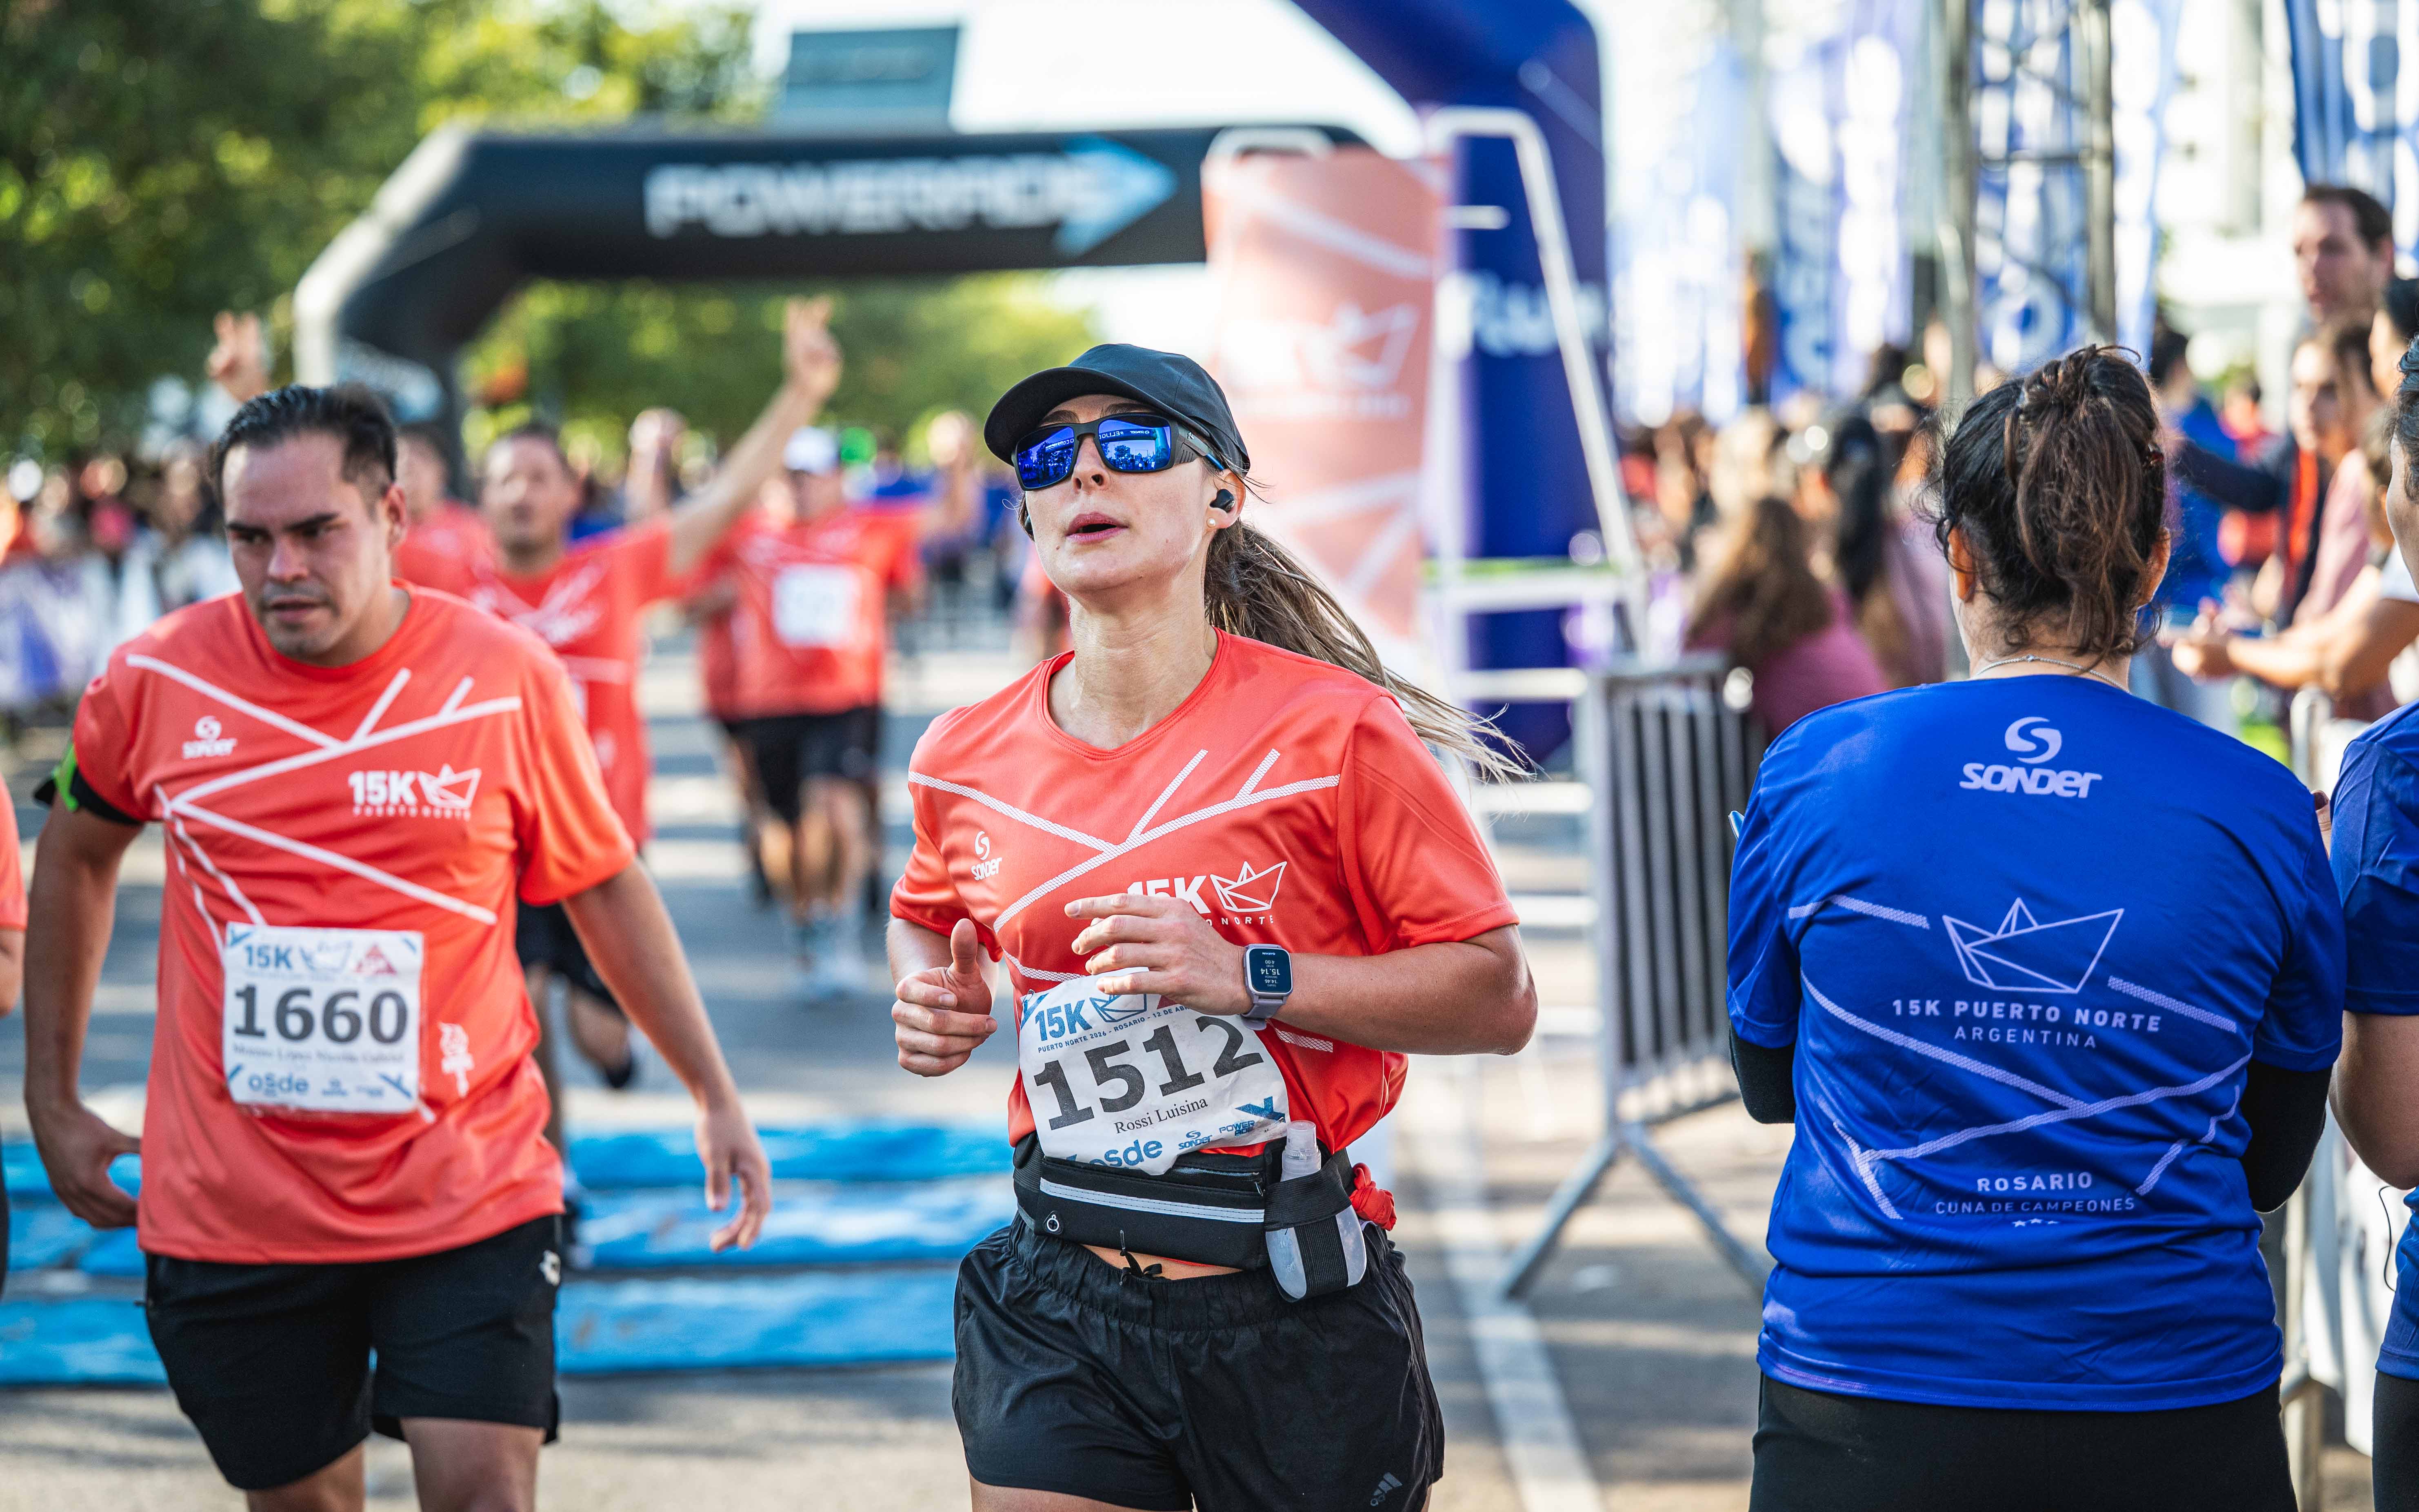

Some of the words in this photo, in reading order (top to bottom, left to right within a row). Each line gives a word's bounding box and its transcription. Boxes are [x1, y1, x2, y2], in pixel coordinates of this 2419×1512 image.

[348, 770, 418, 806] 15K
[1221, 915, 1274, 926] NORTE
[244, 944, 292, 970] 15K
[233, 984, 408, 1044] 1660
[1035, 1000, 1093, 1041] 15K
[1892, 999, 1941, 1017] 15K
[1954, 1001, 2061, 1022] PUERTO
[2074, 1008, 2162, 1032] NORTE
[1038, 1042, 1063, 1053] PUERTO
[1065, 1035, 1088, 1046] NORTE
[1113, 1017, 1145, 1032] ROSARIO
[1954, 1026, 2097, 1049] ARGENTINA
[248, 1072, 309, 1093] osde
[1034, 1016, 1264, 1130] 1512
[1114, 1117, 1153, 1134] Rossi
[1155, 1098, 1208, 1123] Luisina
[1219, 1120, 1255, 1134] POWER
[1976, 1172, 2092, 1192] ROSARIO
[1935, 1201, 1986, 1214] CUNA
[1991, 1202, 2014, 1212] DE
[2020, 1197, 2135, 1213] CAMPEONES
